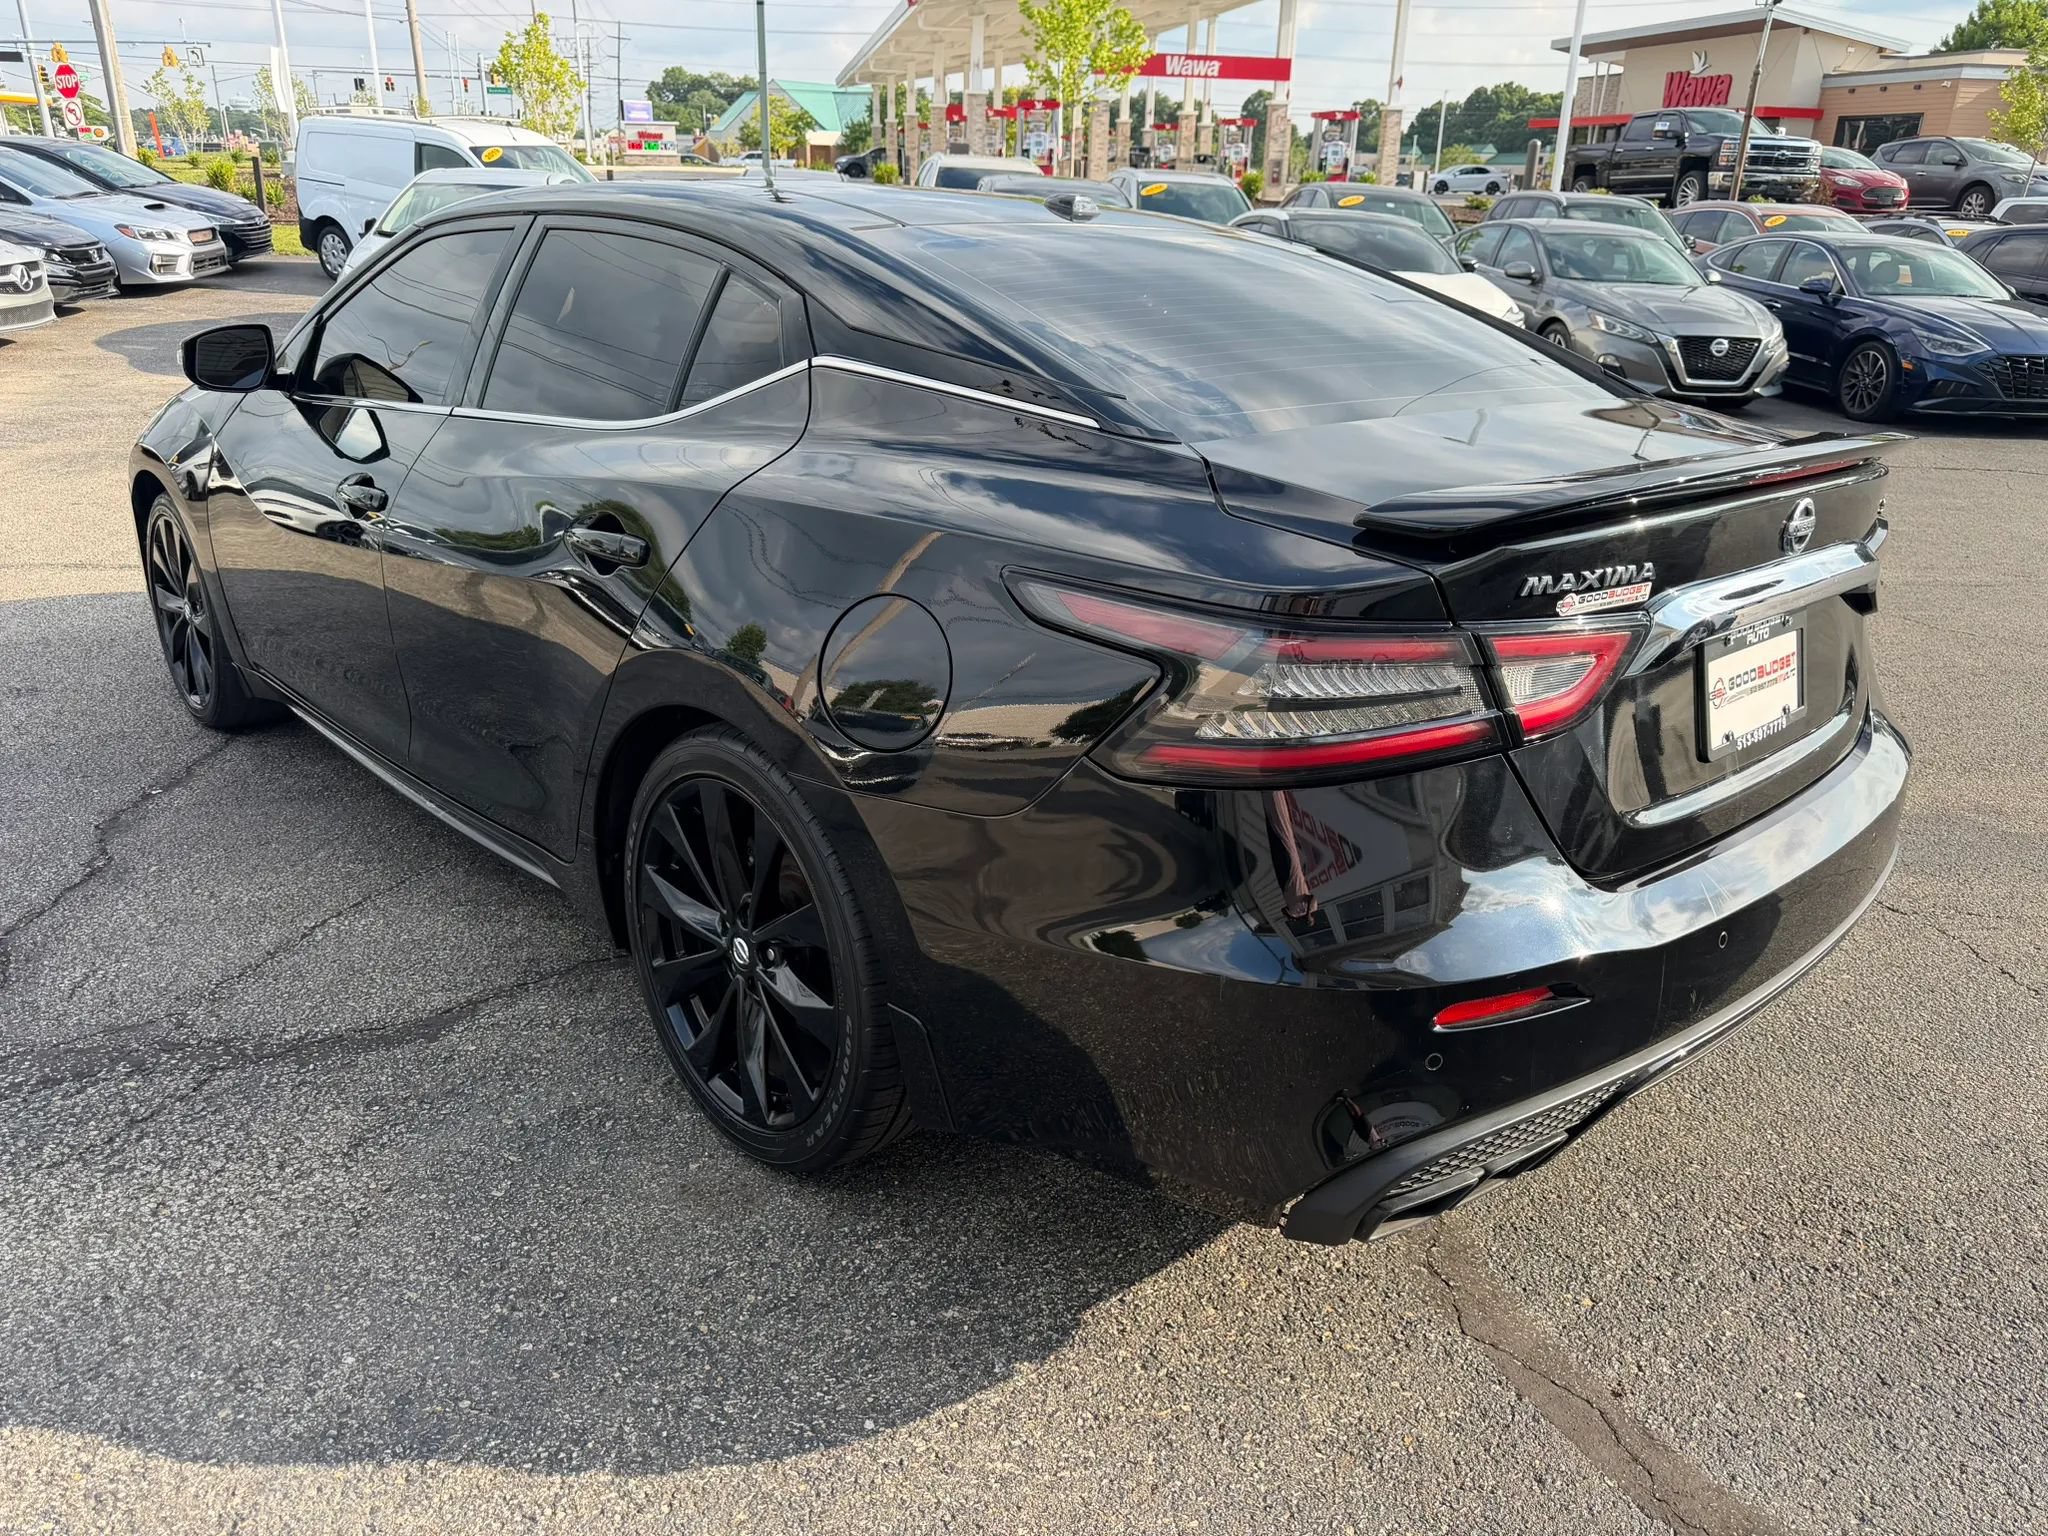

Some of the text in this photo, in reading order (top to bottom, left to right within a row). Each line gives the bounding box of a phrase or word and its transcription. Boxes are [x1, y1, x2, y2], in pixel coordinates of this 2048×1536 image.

[1165, 55, 1220, 77] Wawa
[56, 74, 77, 89] STOP
[1663, 71, 1732, 108] Wawa
[1520, 562, 1656, 597] MAXIMA
[1746, 628, 1770, 646] AUTO
